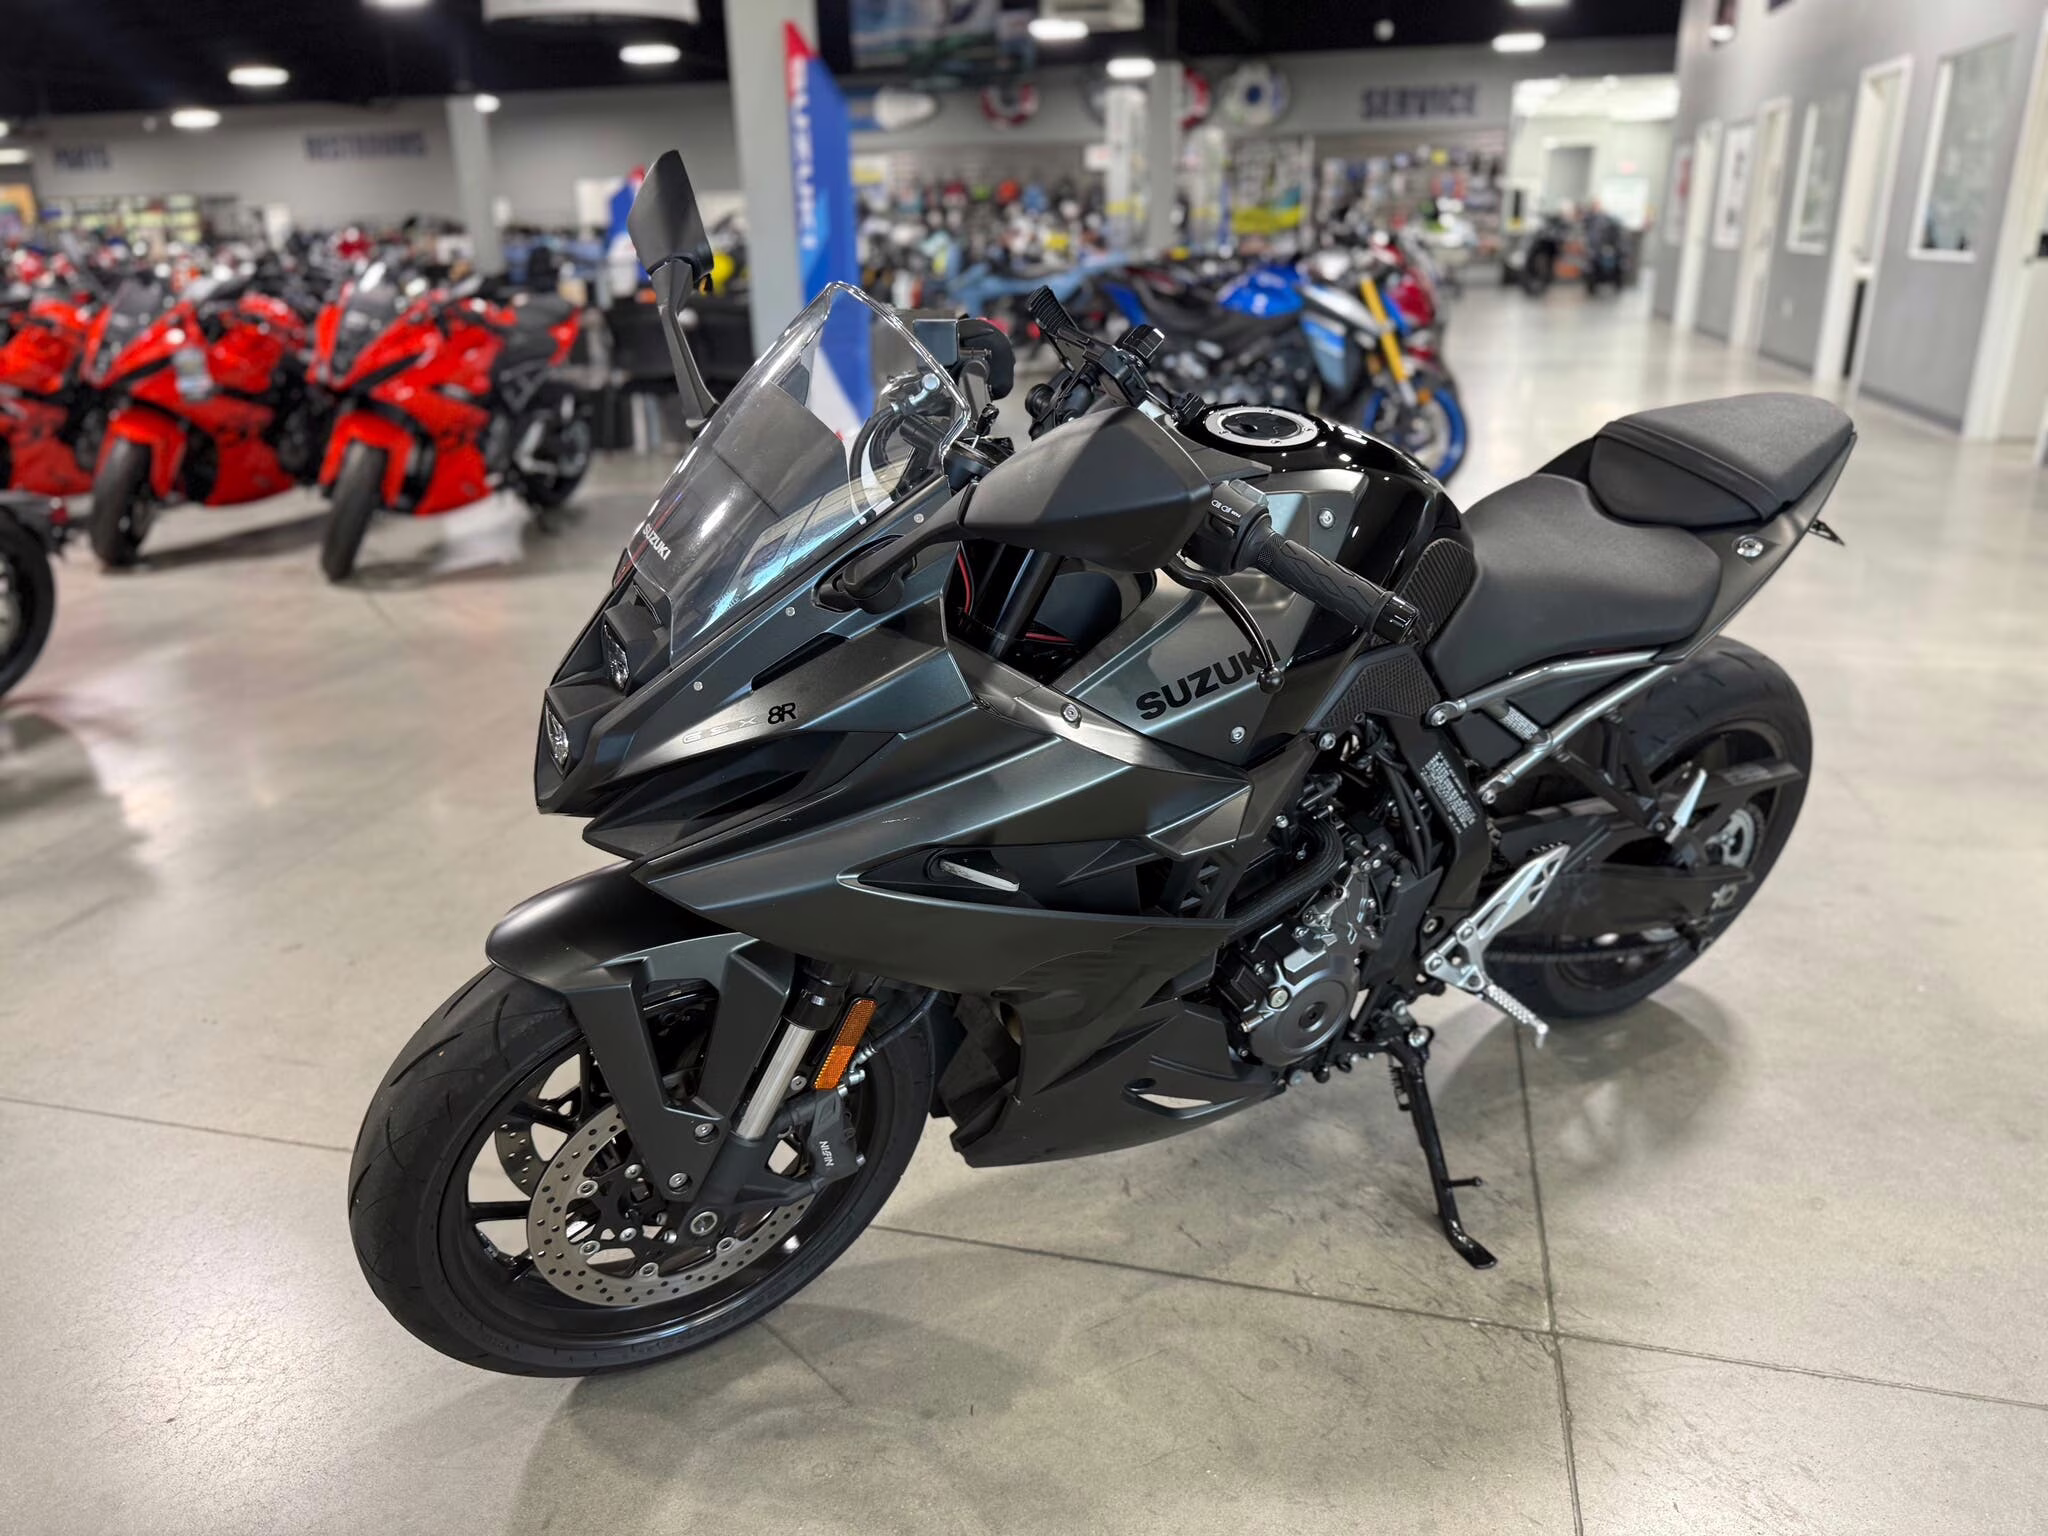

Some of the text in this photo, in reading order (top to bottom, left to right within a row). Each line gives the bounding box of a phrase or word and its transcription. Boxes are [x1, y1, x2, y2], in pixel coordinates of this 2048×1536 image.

[642, 523, 672, 561] SUZUKI
[683, 702, 797, 744] GSX 8R
